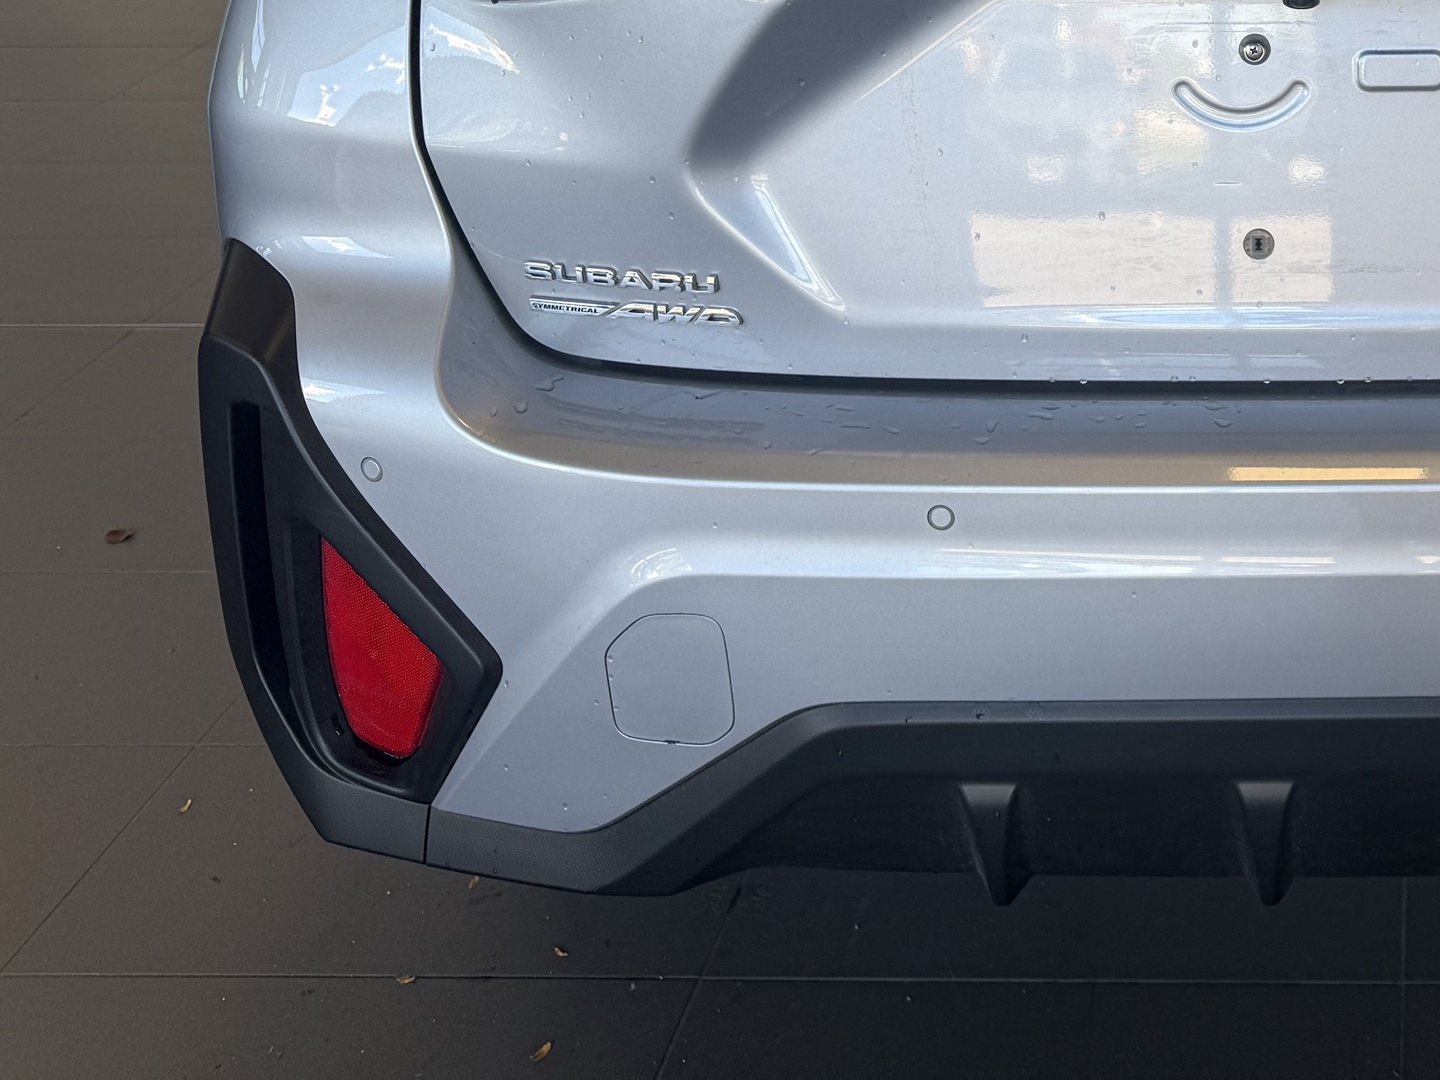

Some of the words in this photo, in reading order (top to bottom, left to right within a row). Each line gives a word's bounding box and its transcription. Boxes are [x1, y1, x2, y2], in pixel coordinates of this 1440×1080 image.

[523, 260, 720, 295] SUBARU
[531, 302, 600, 314] SYMMETRICAL
[606, 300, 744, 327] AWD
